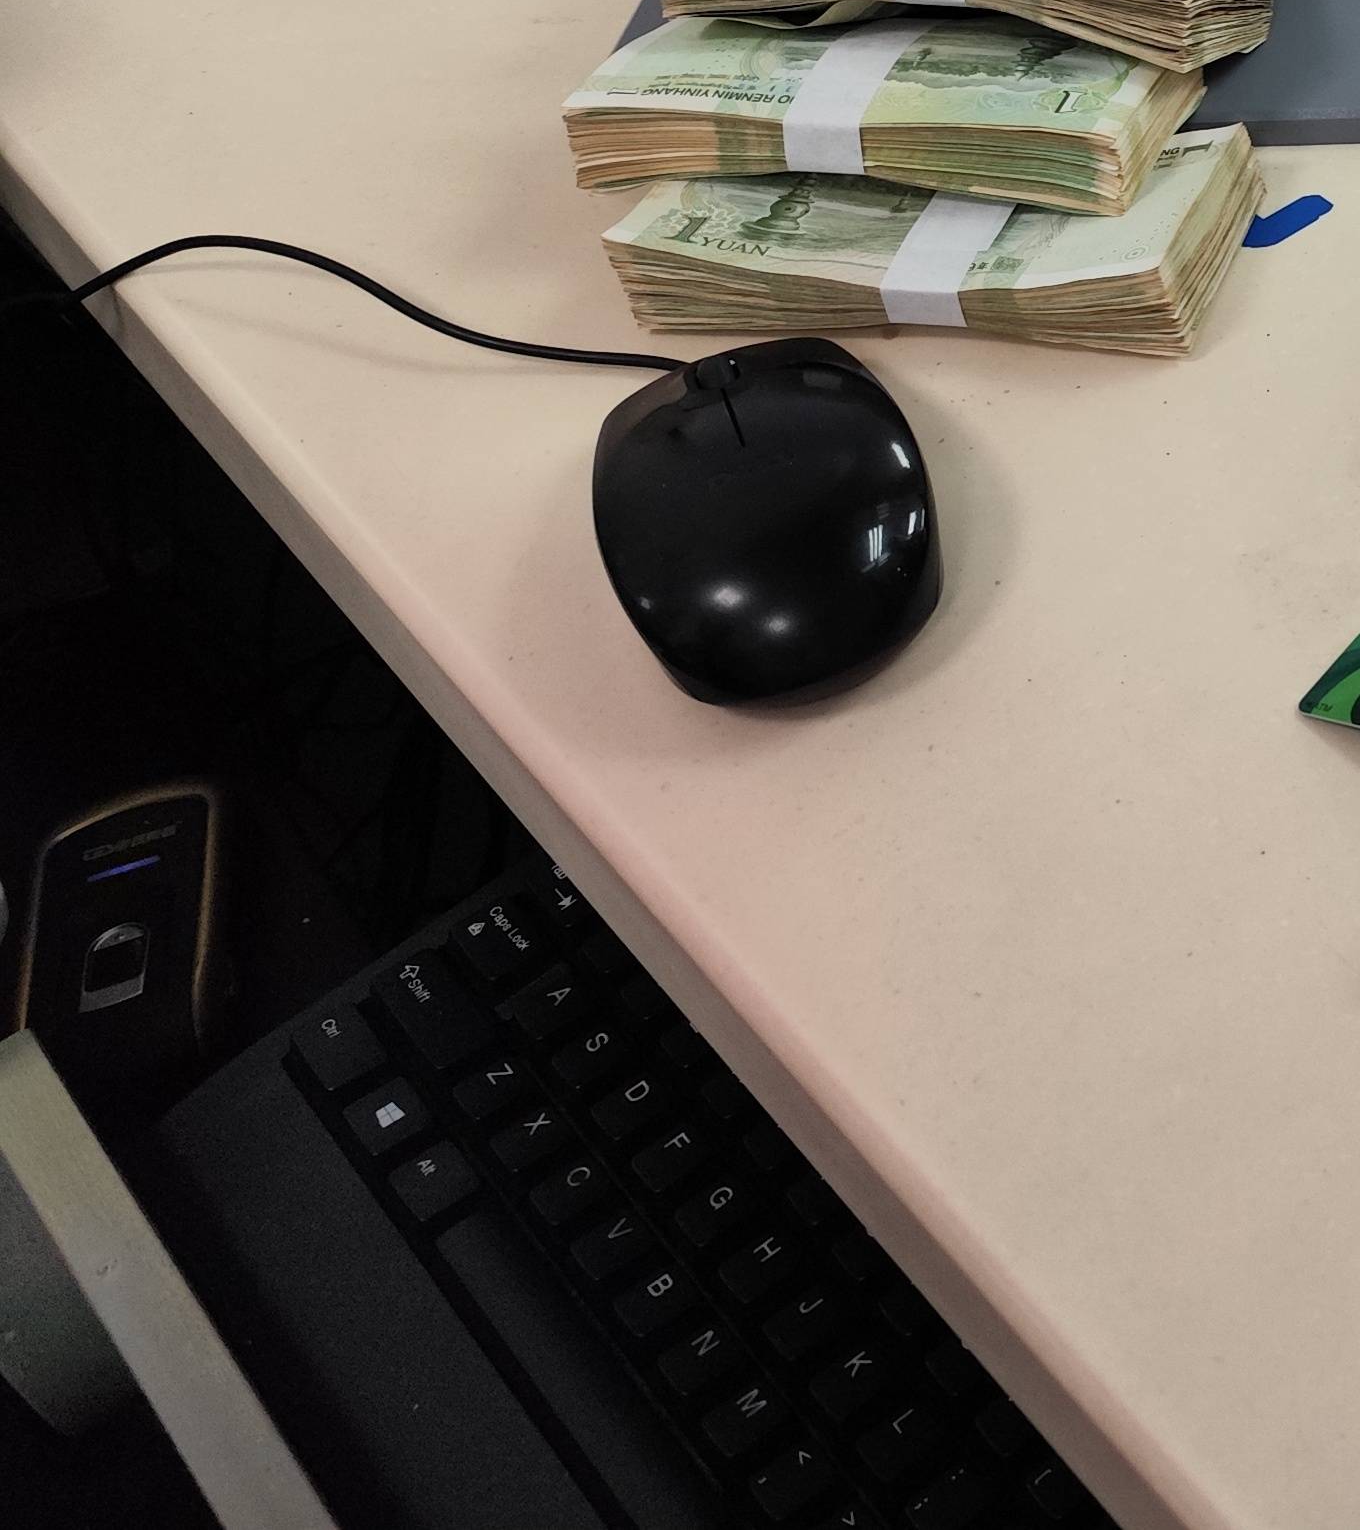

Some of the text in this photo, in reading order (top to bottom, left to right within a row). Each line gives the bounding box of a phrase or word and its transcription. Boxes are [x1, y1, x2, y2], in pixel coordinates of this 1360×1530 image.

[700, 236, 772, 258] YUAN
[489, 904, 533, 952] Caps Lock
[407, 977, 433, 1004] Shift
[545, 983, 573, 1009] A
[319, 1018, 343, 1040] Ctrl
[486, 1062, 514, 1087] Z
[416, 1158, 438, 1177] Alt
[753, 1235, 782, 1263] H
[646, 1272, 674, 1298] B
[735, 1388, 768, 1418] M
[892, 1408, 914, 1434] L
